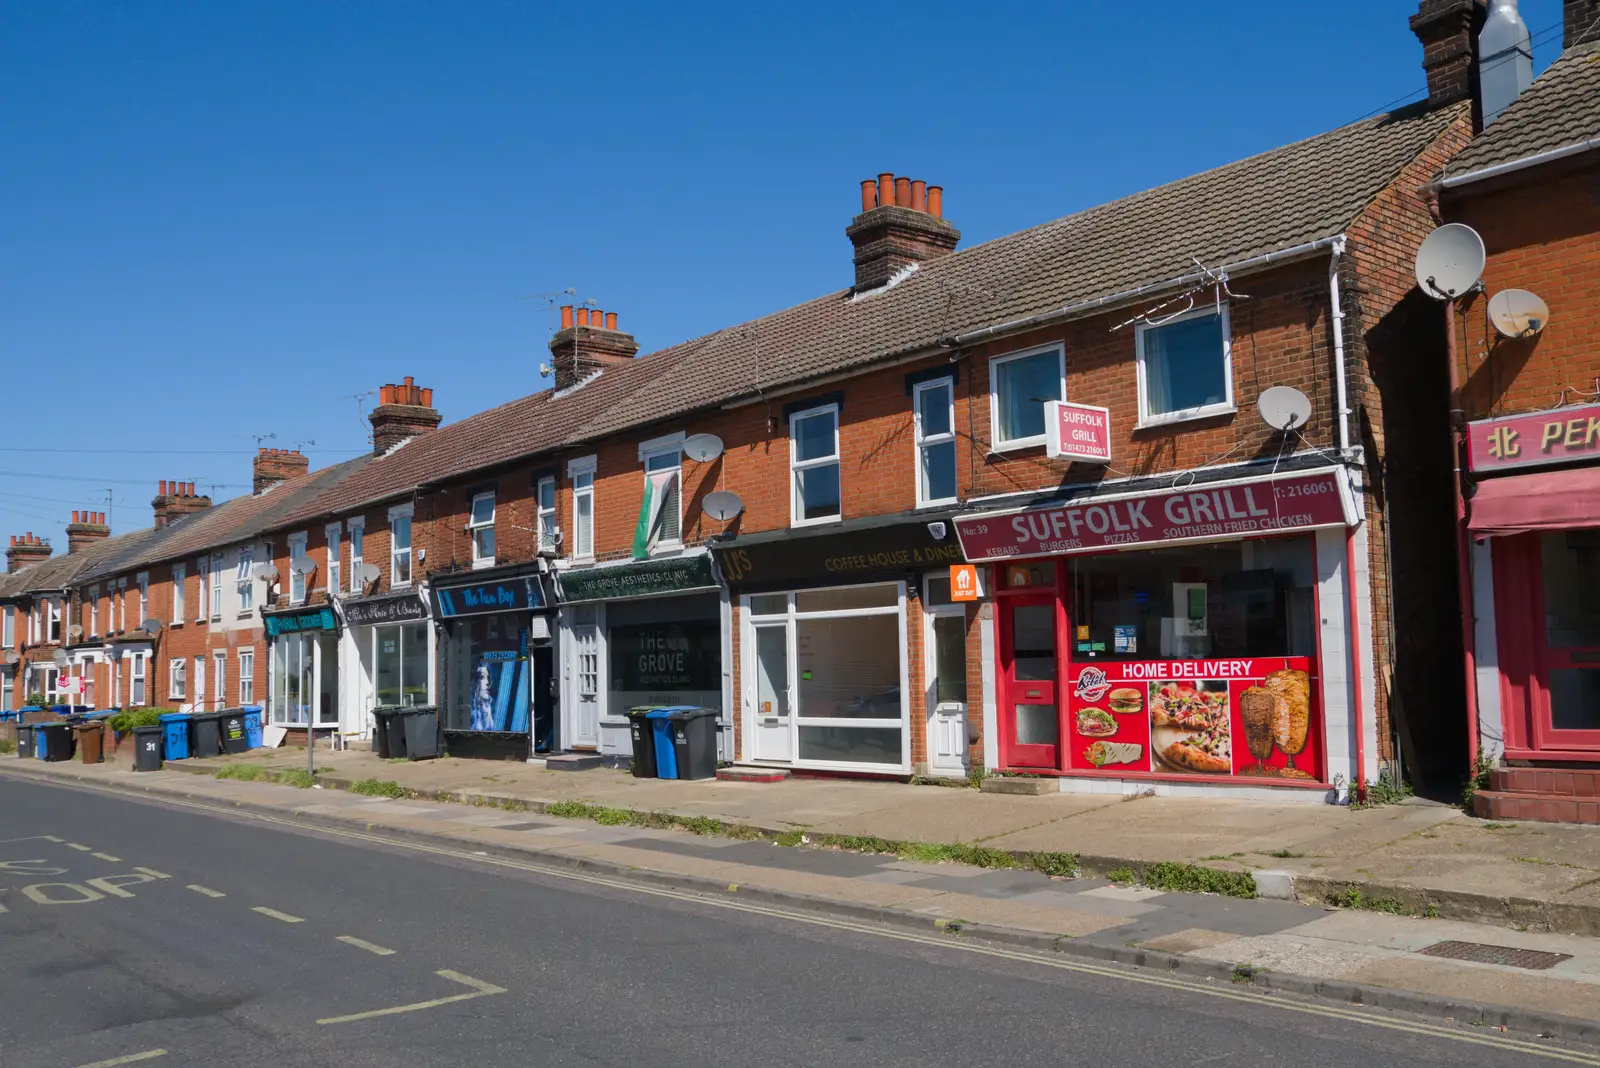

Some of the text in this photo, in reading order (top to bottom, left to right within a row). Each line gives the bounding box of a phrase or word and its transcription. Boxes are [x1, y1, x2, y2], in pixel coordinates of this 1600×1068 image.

[1063, 412, 1104, 427] SUFFOLK
[1072, 429, 1096, 443] GRILL
[1487, 426, 1520, 457] 北
[1086, 445, 1106, 455] 216061
[1287, 481, 1334, 498] 216061
[1011, 487, 1269, 543] SUFFOLK GRILL
[963, 524, 989, 537] No: 39
[985, 513, 1313, 557] KEBABS BURGERS PIZZAS SOUTHERN FRIED CHICKEN
[723, 550, 752, 580] JJ'S
[825, 555, 868, 572] COFFEE
[869, 550, 910, 567] HOUSE
[913, 548, 923, 562] &
[598, 577, 619, 588] GROVE
[621, 572, 662, 586] AESTHETICS
[663, 569, 689, 582] CLINIC
[397, 601, 422, 618] Beauty
[639, 631, 665, 650] THE
[639, 652, 684, 672] GROVE
[1122, 660, 1253, 678] HOME DELIVERY
[146, 742, 156, 752] 31
